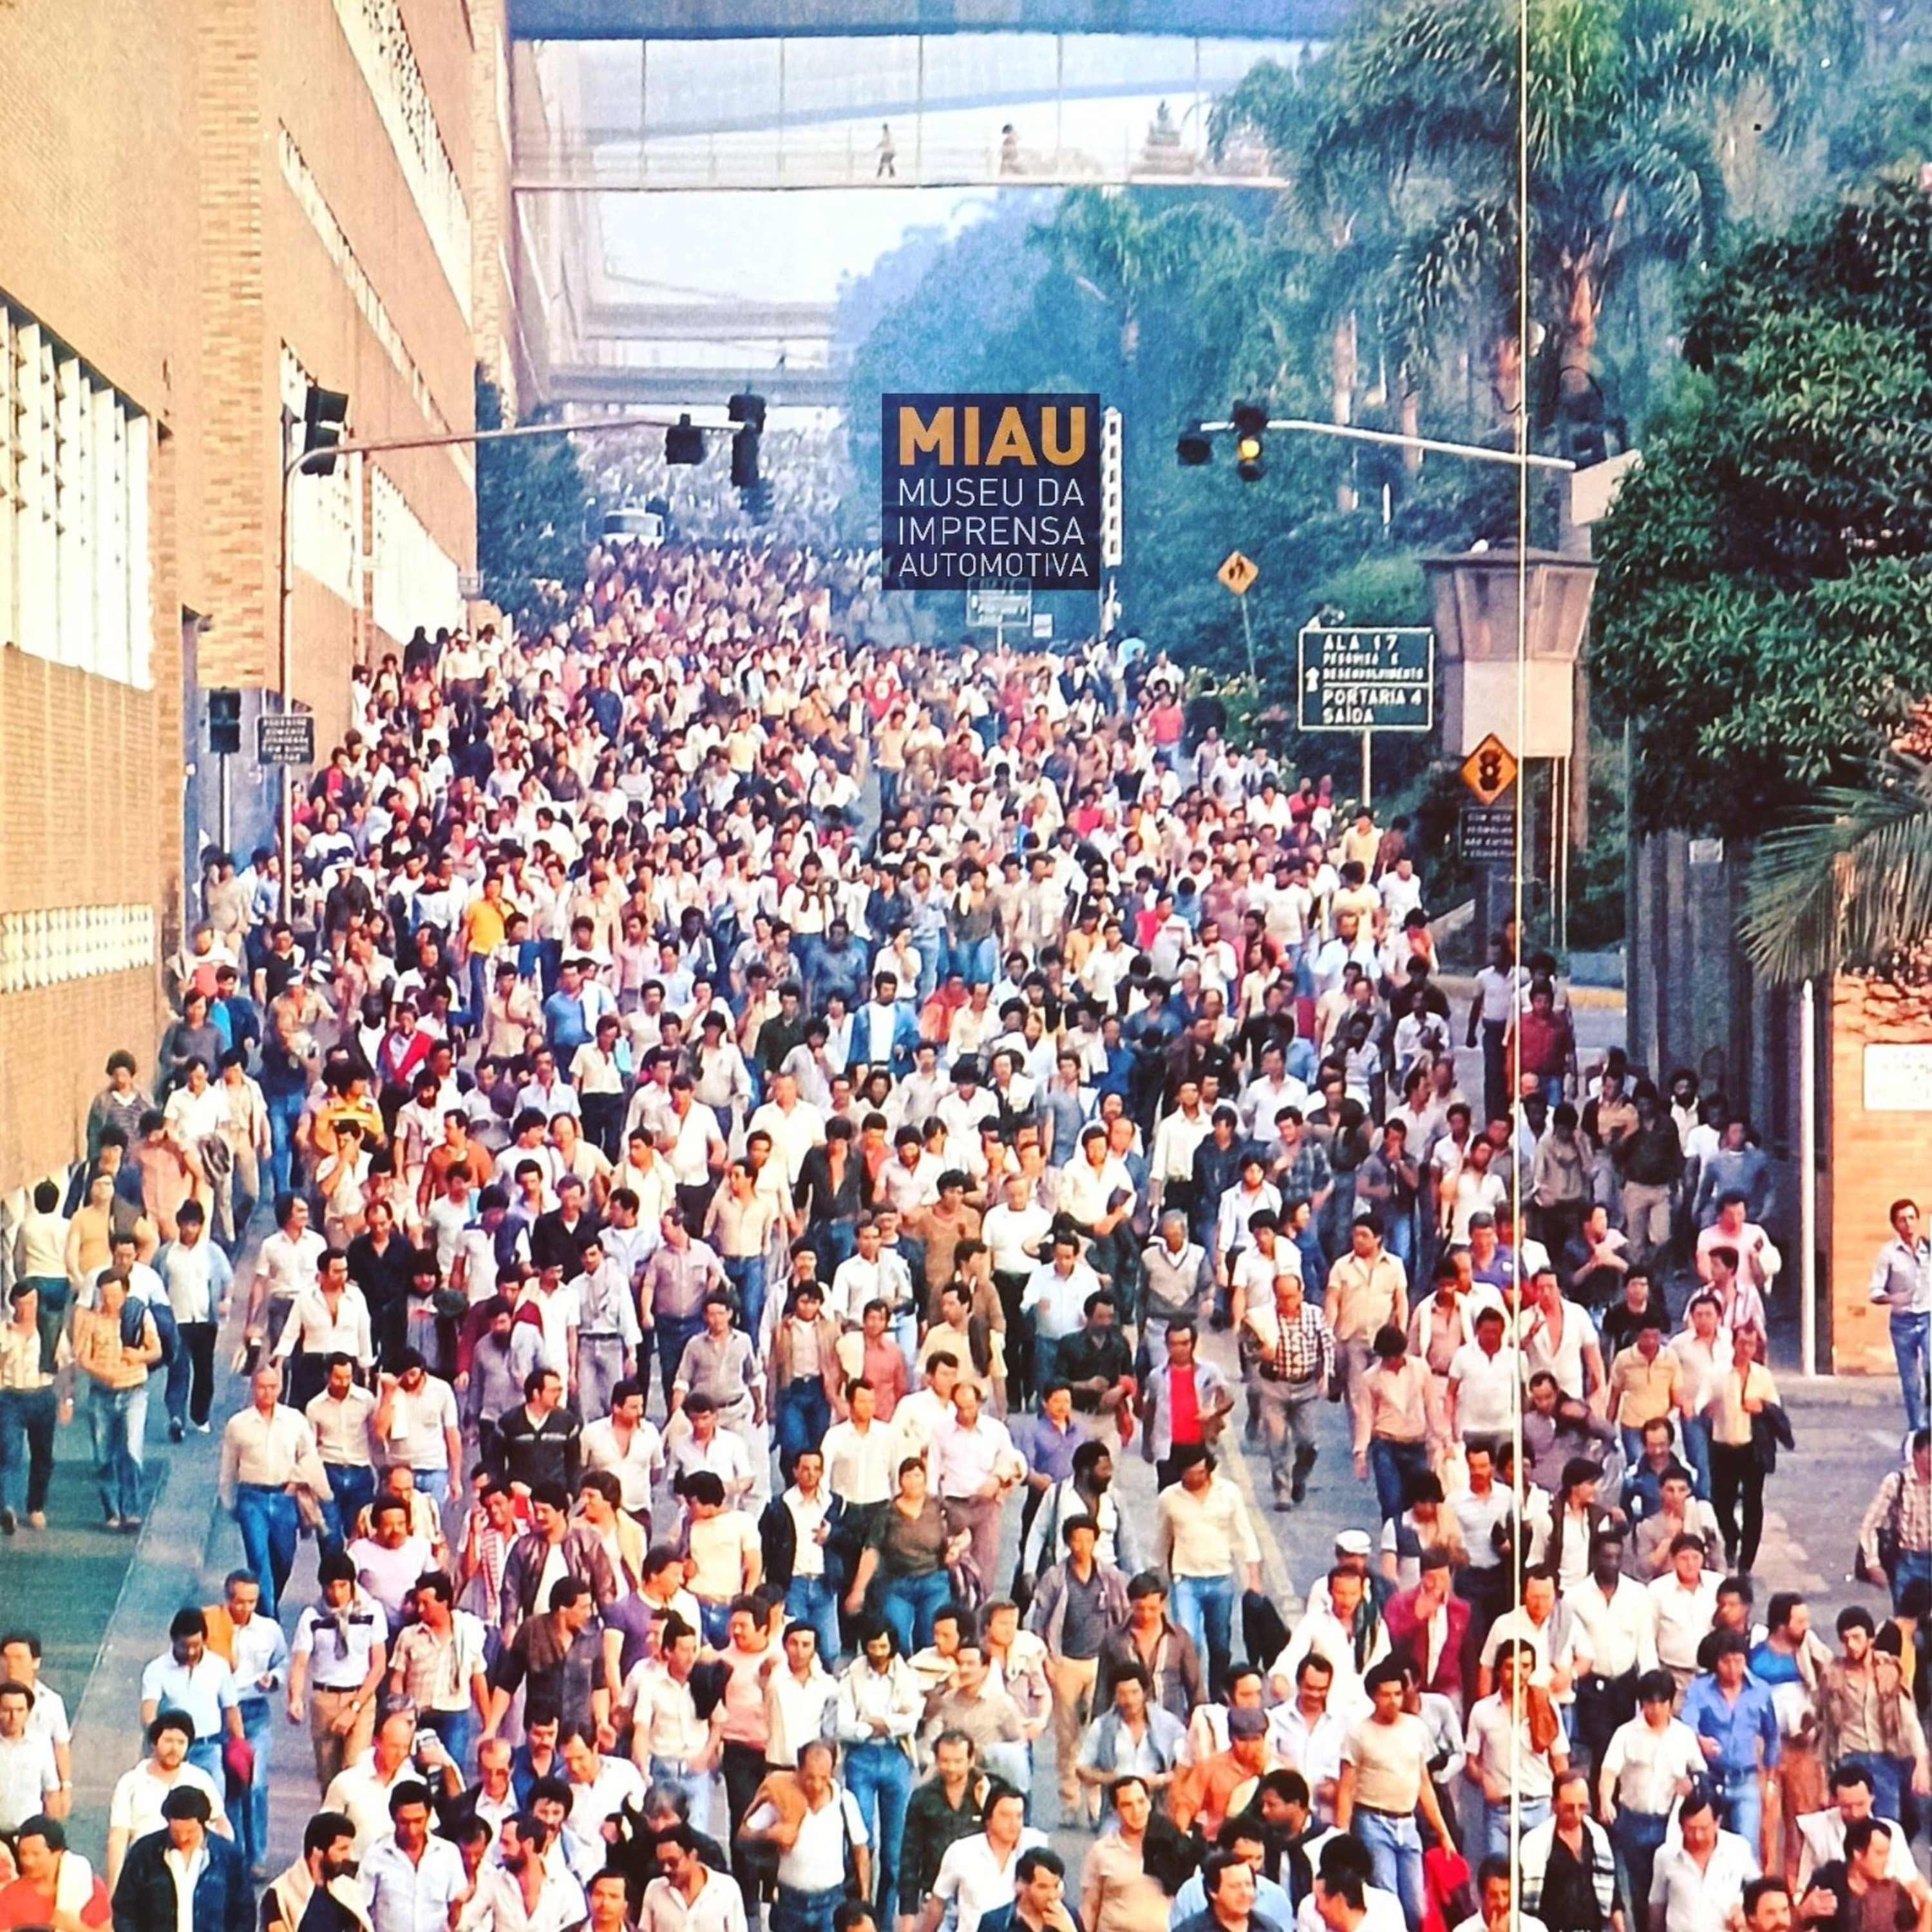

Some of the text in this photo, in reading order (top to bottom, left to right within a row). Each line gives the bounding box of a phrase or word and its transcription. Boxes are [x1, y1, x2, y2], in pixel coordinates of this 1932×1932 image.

[1323, 634, 1398, 651] ALA 17
[1323, 688, 1422, 706] PORTARIA 4
